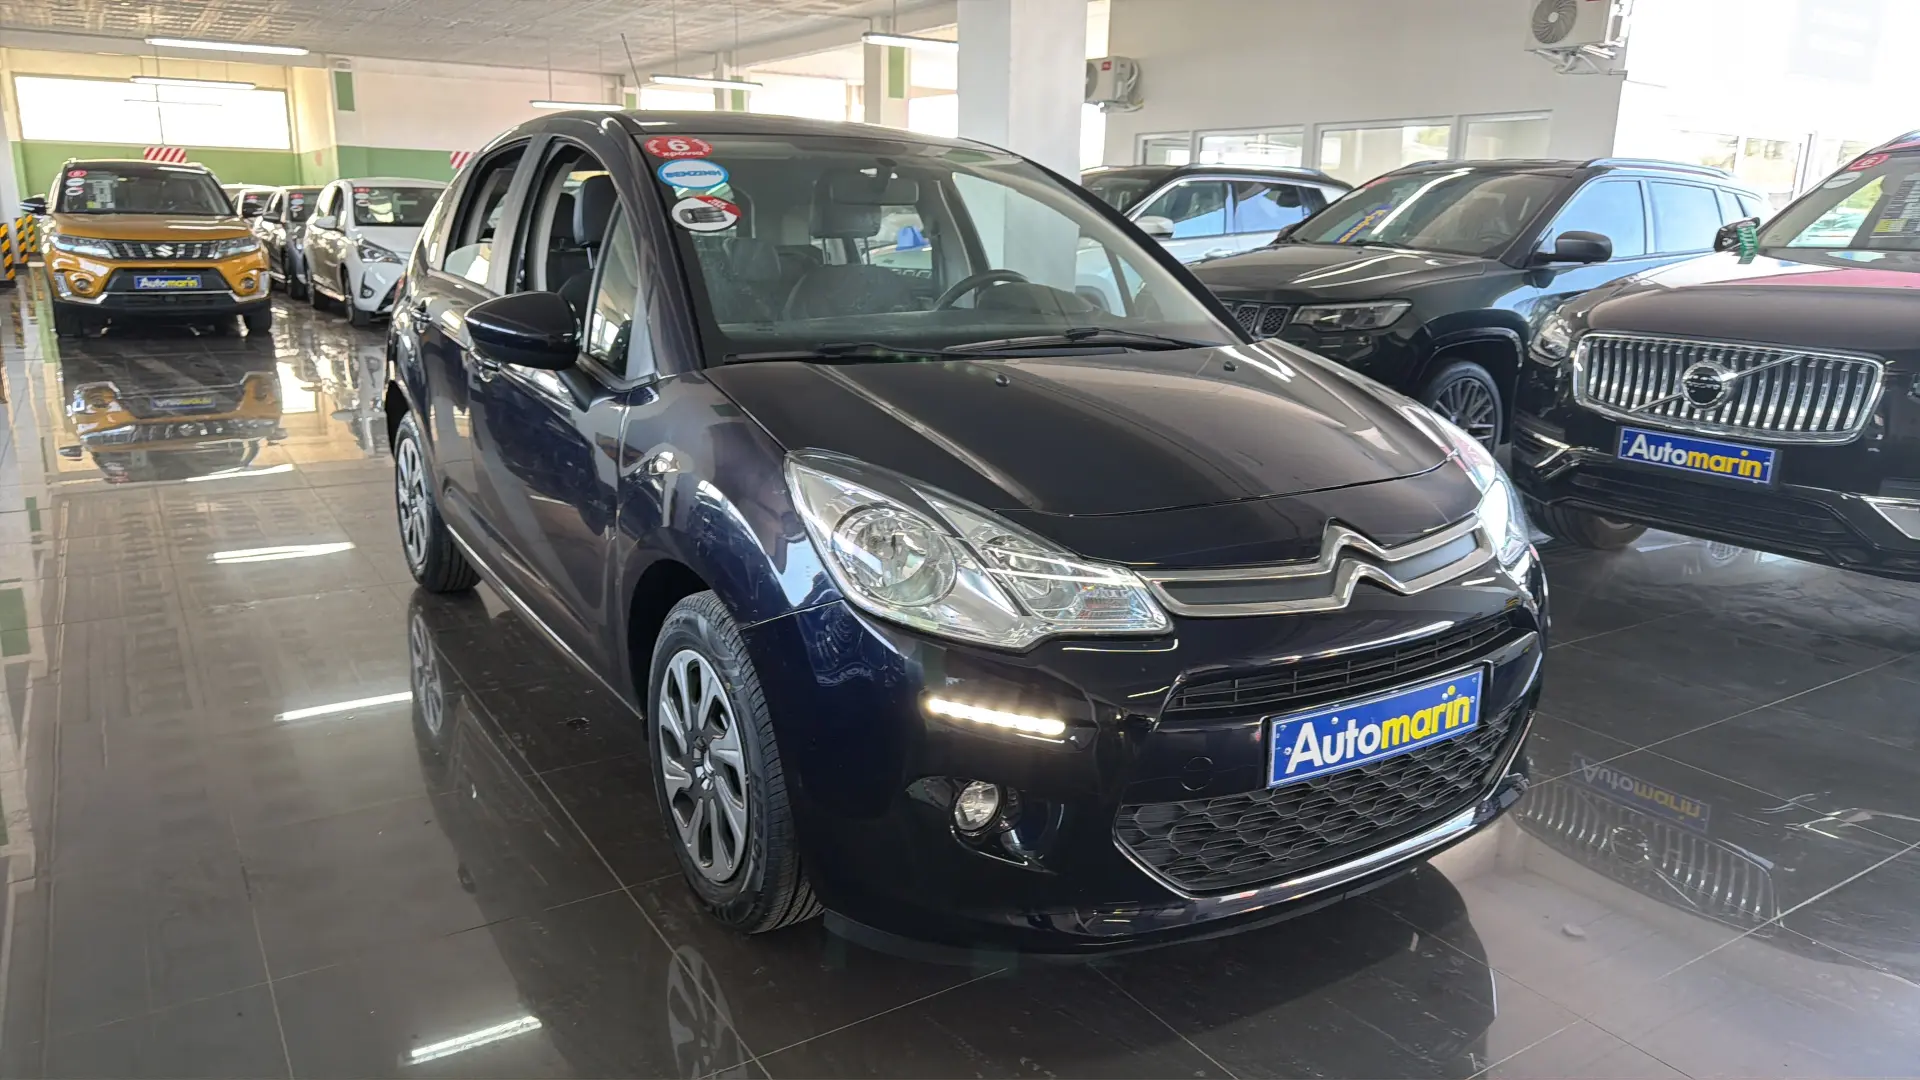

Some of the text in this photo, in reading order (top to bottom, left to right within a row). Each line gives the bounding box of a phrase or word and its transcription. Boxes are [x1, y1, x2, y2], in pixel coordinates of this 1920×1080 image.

[667, 138, 690, 151] 6
[139, 277, 198, 288] Automarin
[1628, 434, 1762, 479] Automarin
[1285, 685, 1470, 774] Automarin
